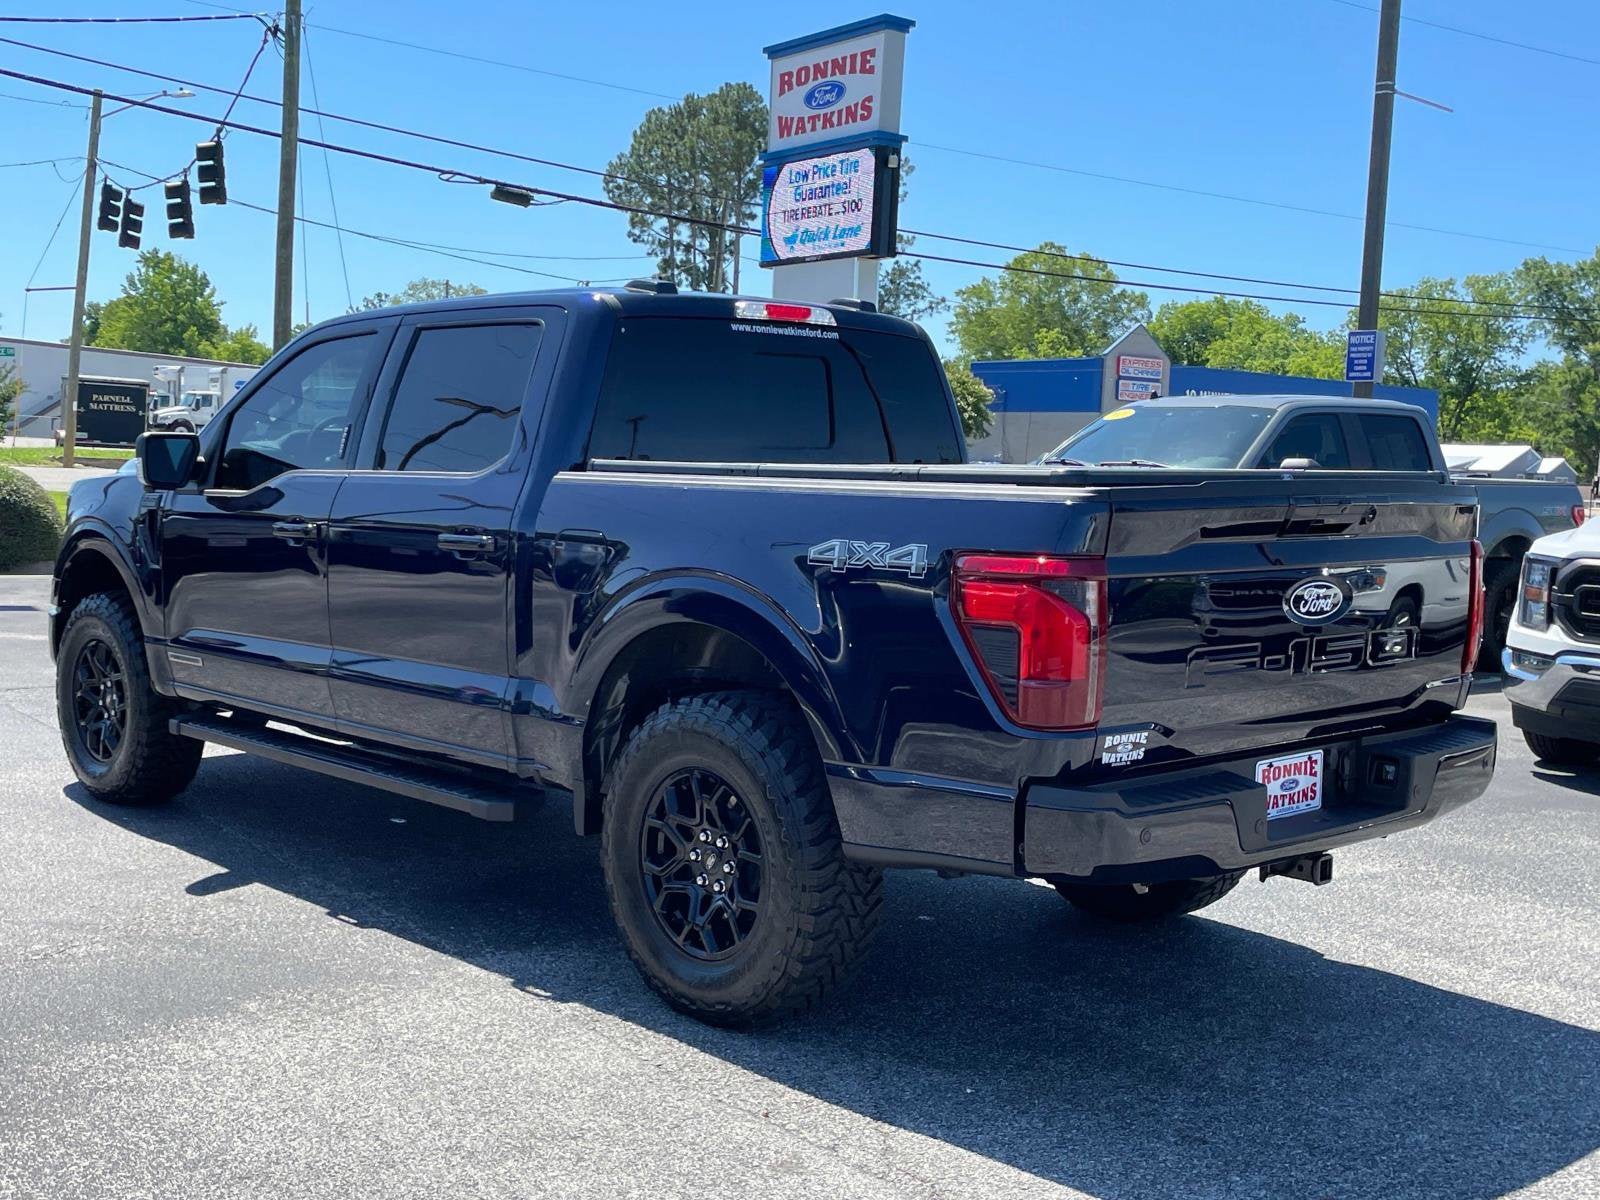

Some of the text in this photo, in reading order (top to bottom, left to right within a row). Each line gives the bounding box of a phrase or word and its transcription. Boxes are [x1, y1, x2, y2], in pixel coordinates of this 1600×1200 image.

[778, 48, 877, 97] RONNIE
[811, 85, 839, 107] Ford
[777, 95, 874, 139] WATKINS
[789, 158, 860, 184] Low Price Tire
[793, 177, 852, 203] Guarantee!
[783, 206, 800, 224] TIRE
[800, 202, 833, 221] REBATE
[800, 221, 863, 245] Quick Lane
[730, 322, 840, 340] www.ronniewatkinsford.com
[1349, 334, 1375, 345] NOTICE
[1120, 358, 1162, 369] EXPRESS
[1120, 367, 1161, 378] OIL CHANGE
[1131, 382, 1151, 392] TIRE
[88, 403, 136, 412] MATTRESS
[92, 394, 133, 403] PARNELL
[1299, 587, 1334, 613] Ford
[1184, 626, 1420, 689] F-150
[1104, 731, 1149, 749] RONNIE
[1101, 747, 1146, 765] WATKINS
[1261, 759, 1318, 785] RONNIE
